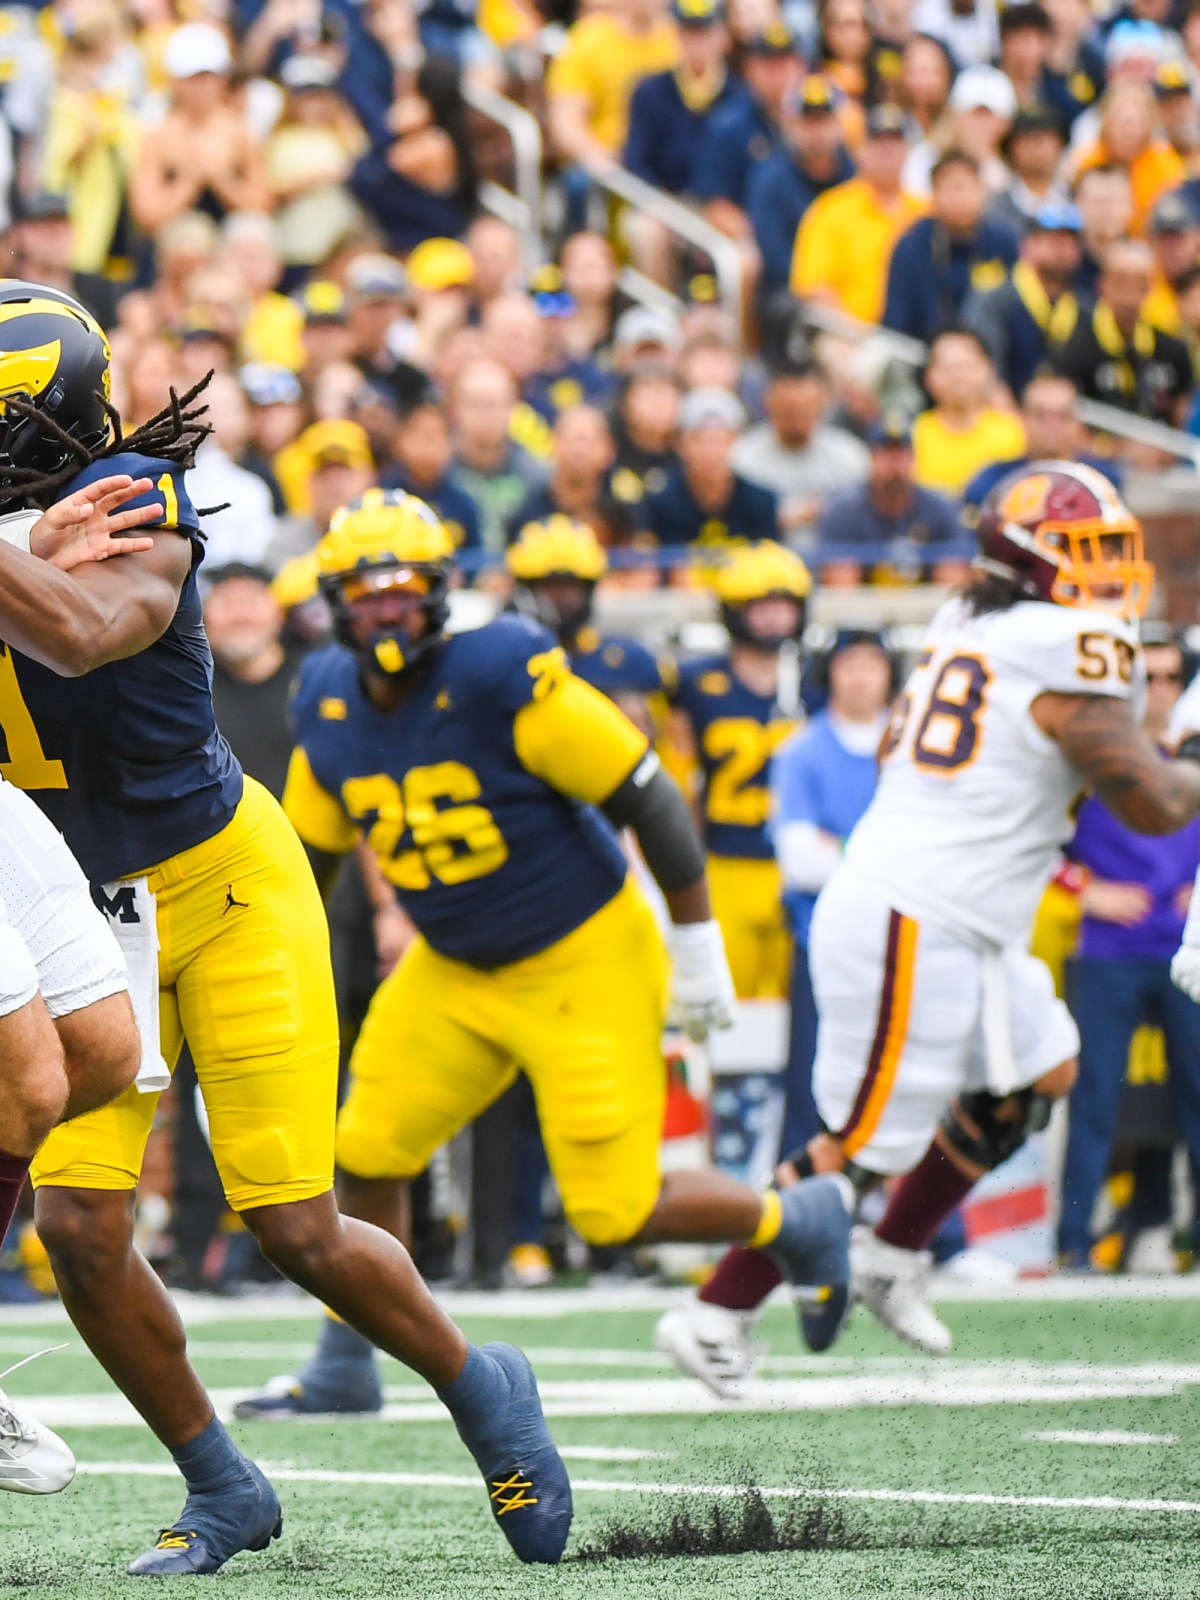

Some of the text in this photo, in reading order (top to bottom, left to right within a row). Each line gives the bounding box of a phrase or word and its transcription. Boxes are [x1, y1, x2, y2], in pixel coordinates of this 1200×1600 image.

[157, 473, 179, 528] 1
[703, 716, 803, 828] 2
[341, 760, 510, 890] 26
[101, 886, 141, 924] M
